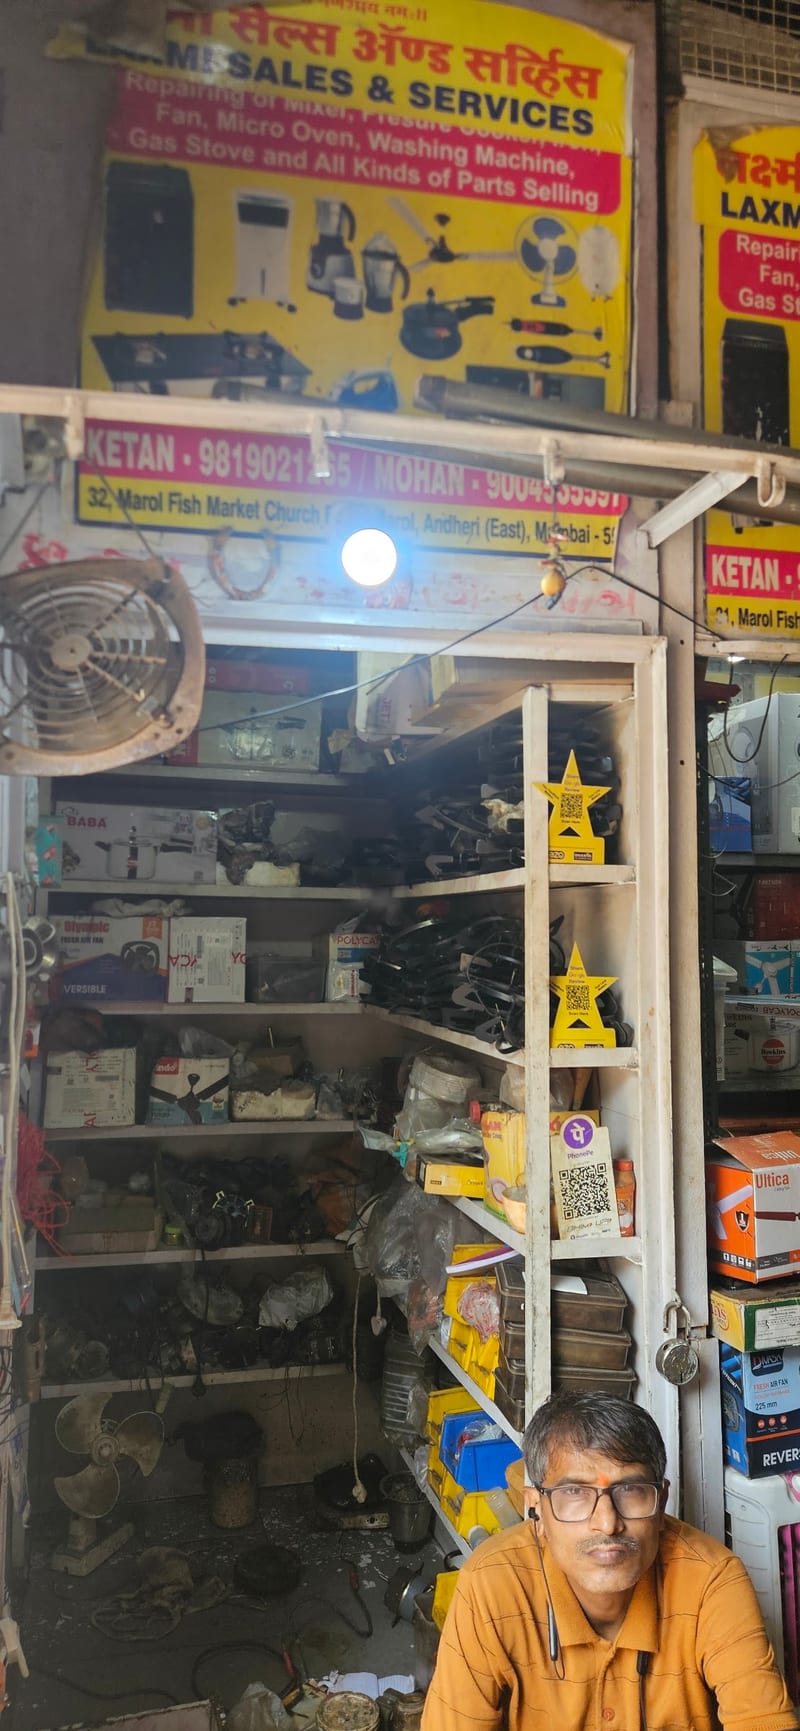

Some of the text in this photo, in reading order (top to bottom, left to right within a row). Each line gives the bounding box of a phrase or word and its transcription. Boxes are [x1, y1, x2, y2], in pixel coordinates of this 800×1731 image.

[227, 51, 353, 97] SALES
[367, 75, 394, 104] &
[408, 81, 594, 136] SERVICES
[156, 102, 208, 130] Fan,
[217, 110, 285, 139] Micro
[291, 120, 361, 151] Oven,
[368, 130, 468, 167] Washing
[475, 144, 575, 180] Machine,
[128, 127, 599, 211] Gas Stove and All Kinds of Parts Selling
[721, 191, 800, 230] LAXM
[759, 264, 800, 291] Fan,
[738, 287, 777, 312] Gas
[87, 427, 175, 472] KETAN
[374, 453, 465, 497] MOHAN
[87, 485, 113, 511] 32,
[117, 489, 163, 512] Marol
[168, 492, 201, 510] Fish
[207, 495, 260, 519] Market
[264, 502, 321, 525] Church
[424, 512, 480, 537] Andheri
[486, 517, 531, 545] (East),
[711, 553, 780, 592] KETAN
[738, 607, 773, 627] Marol
[776, 610, 800, 629] Fish
[67, 816, 107, 829] BABA
[64, 984, 107, 994] VERSIBLE
[567, 1149, 594, 1160] PhonePe
[755, 1172, 790, 1189] Ultica
[754, 1401, 778, 1411] 225 mm
